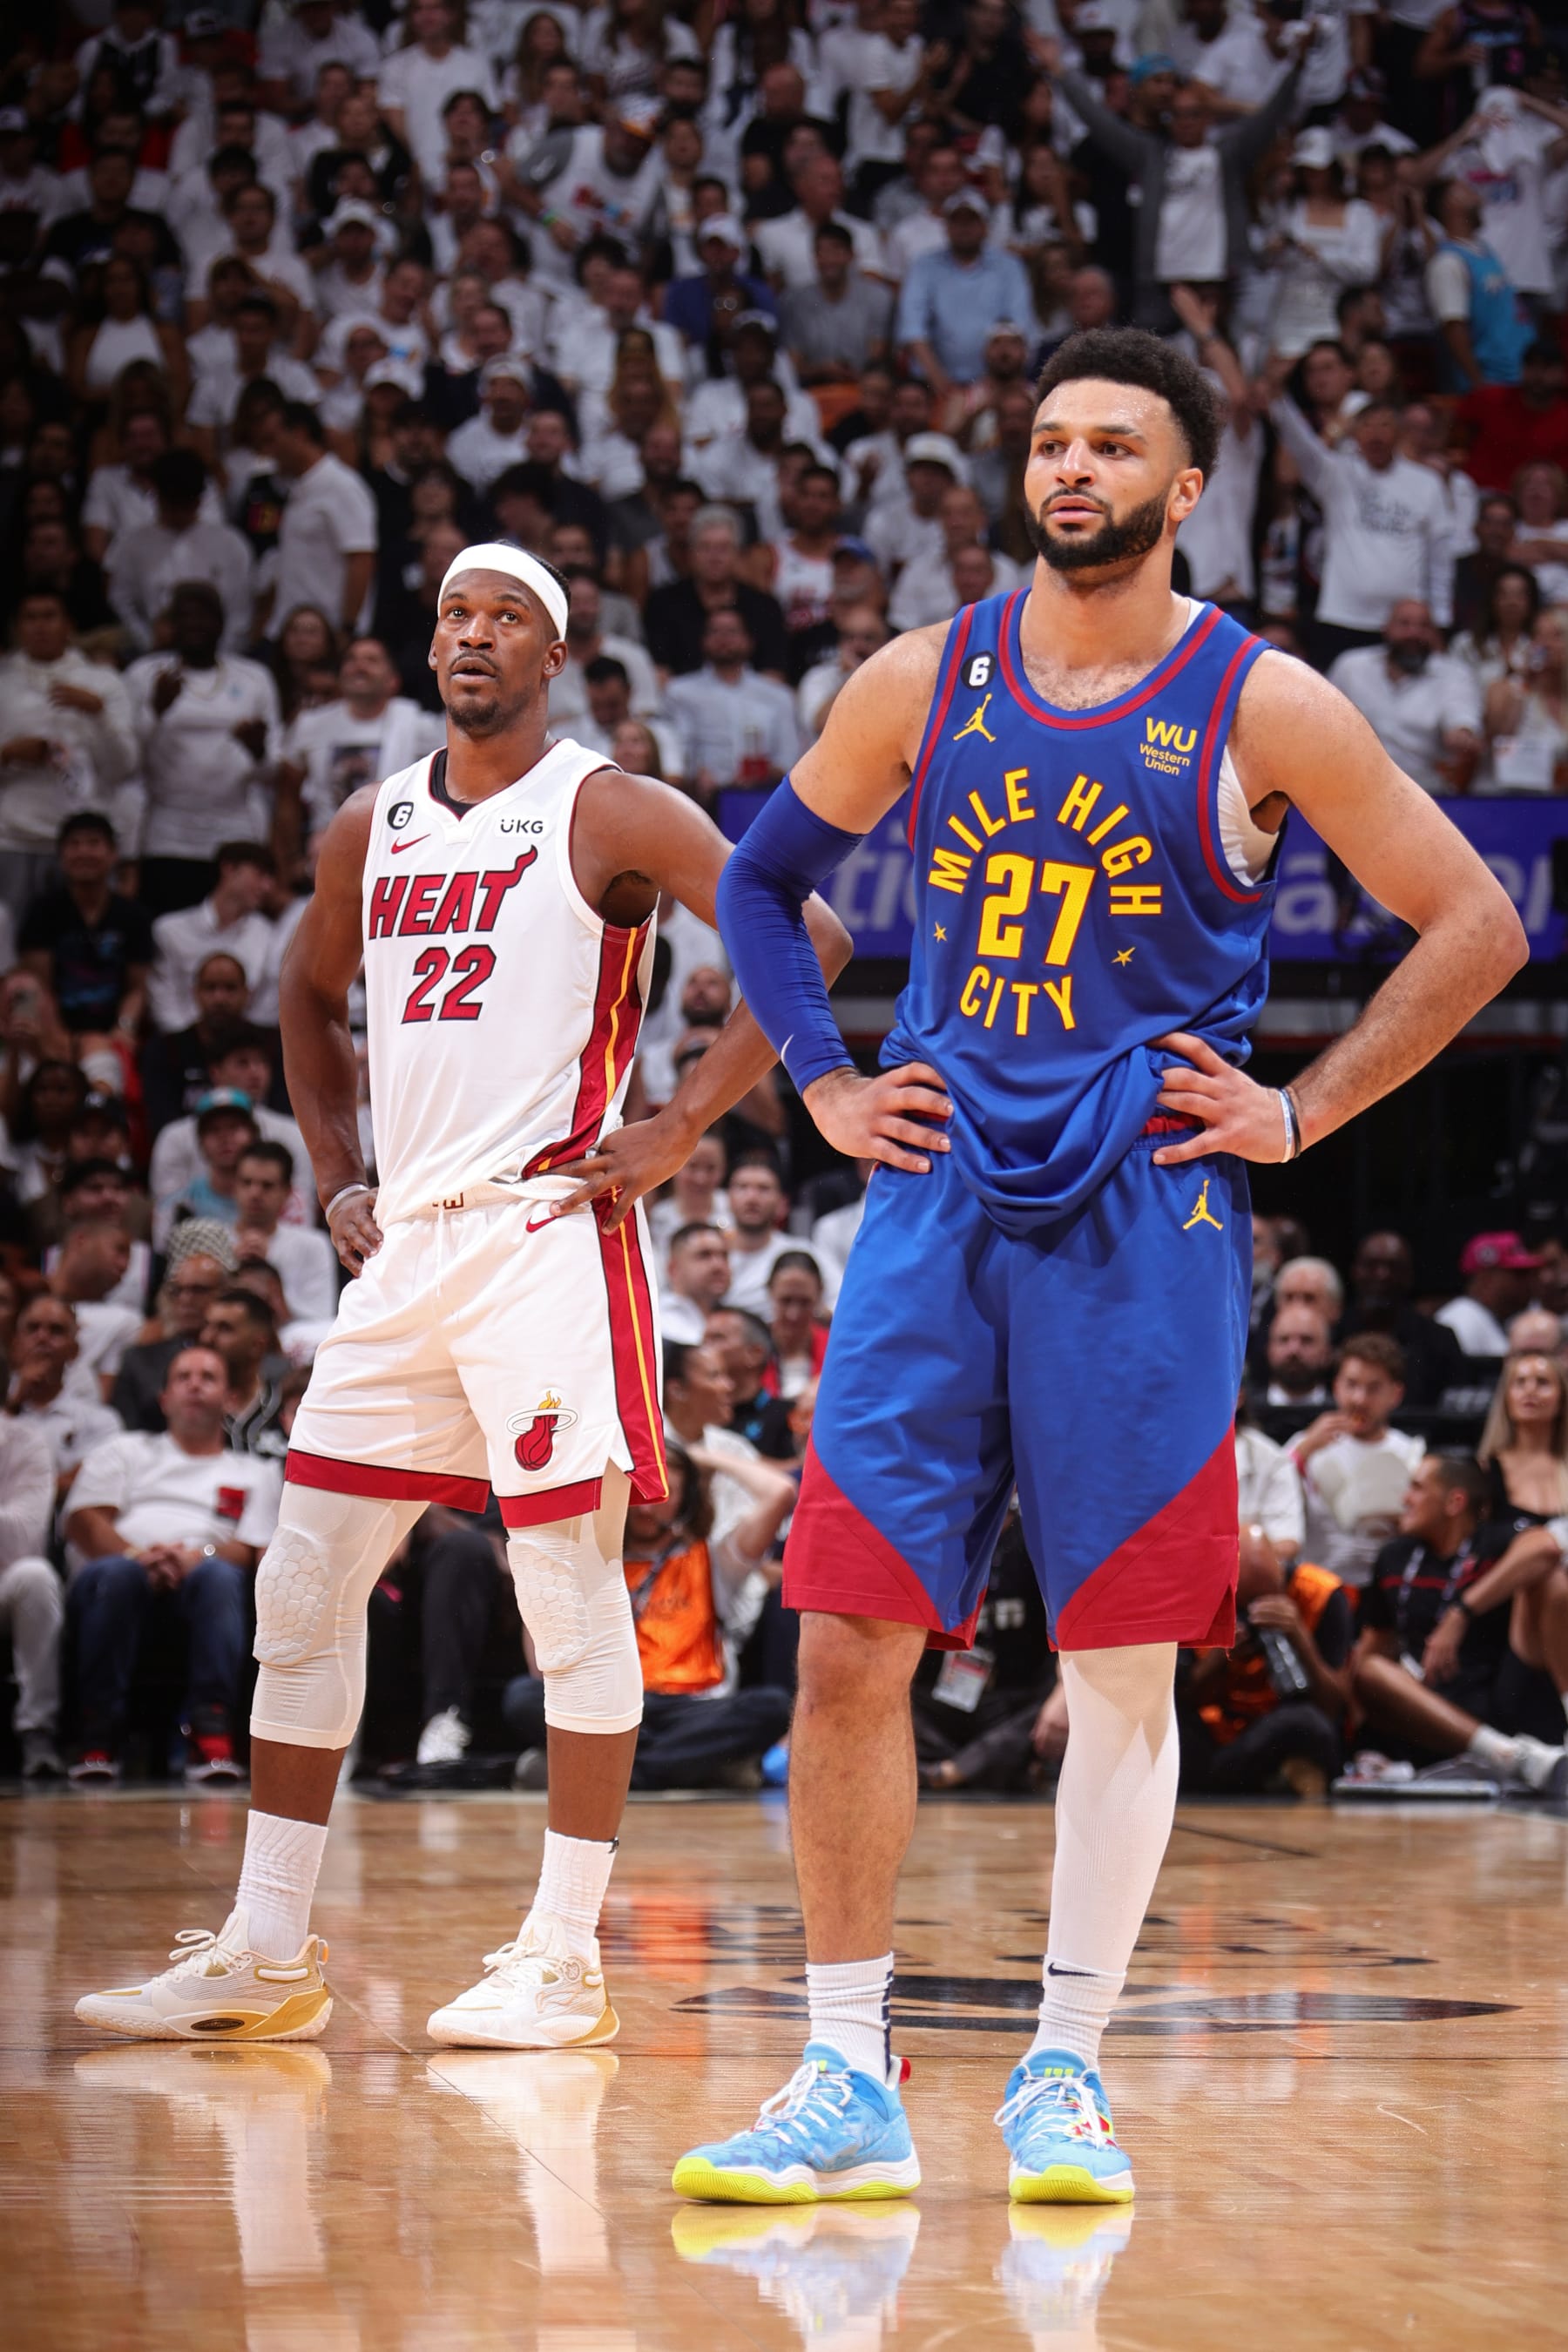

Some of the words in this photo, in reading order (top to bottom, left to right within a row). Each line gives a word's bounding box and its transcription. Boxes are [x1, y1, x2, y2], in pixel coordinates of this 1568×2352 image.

[969, 656, 990, 686] 6
[1139, 742, 1191, 767] Western
[1146, 716, 1198, 753] WU
[1145, 756, 1179, 776] Union
[391, 803, 413, 828] 6
[928, 767, 1036, 895] MILE
[1056, 772, 1163, 916] HIGH
[368, 844, 538, 941] HEAT
[977, 850, 1098, 967] 27
[401, 944, 497, 1024] 22
[959, 963, 1077, 1036] CITY
